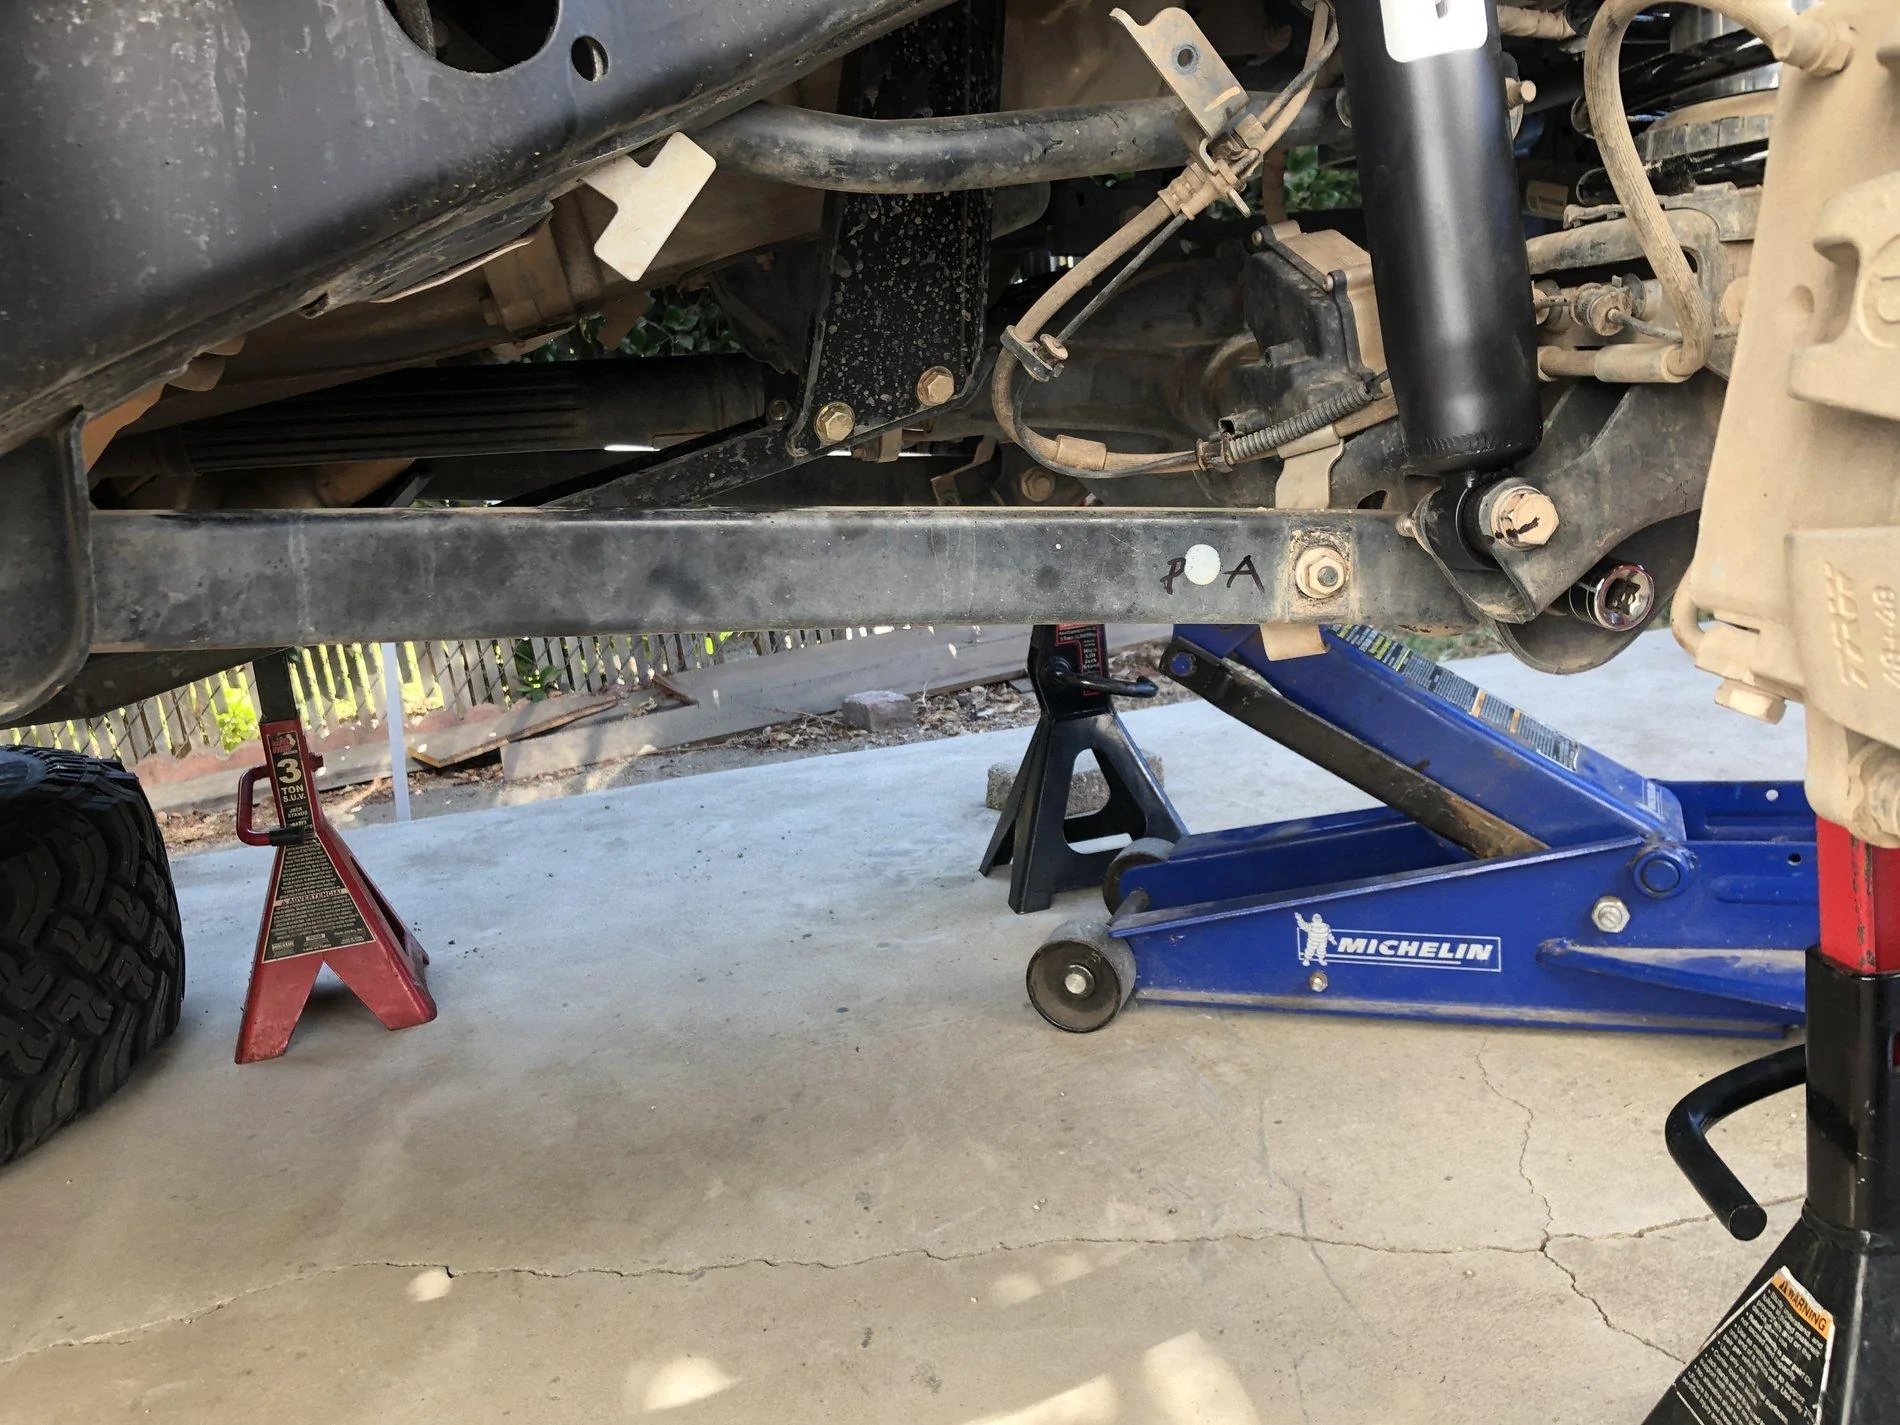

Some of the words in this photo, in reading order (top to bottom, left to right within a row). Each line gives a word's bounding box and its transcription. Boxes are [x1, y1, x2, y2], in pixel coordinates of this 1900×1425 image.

[1223, 555, 1265, 594] A
[277, 758, 302, 784] 3
[281, 784, 304, 796] TON
[283, 793, 306, 803] S.U.V.
[1337, 937, 1493, 961] MICHELIN
[1788, 1289, 1826, 1330] WARNING
